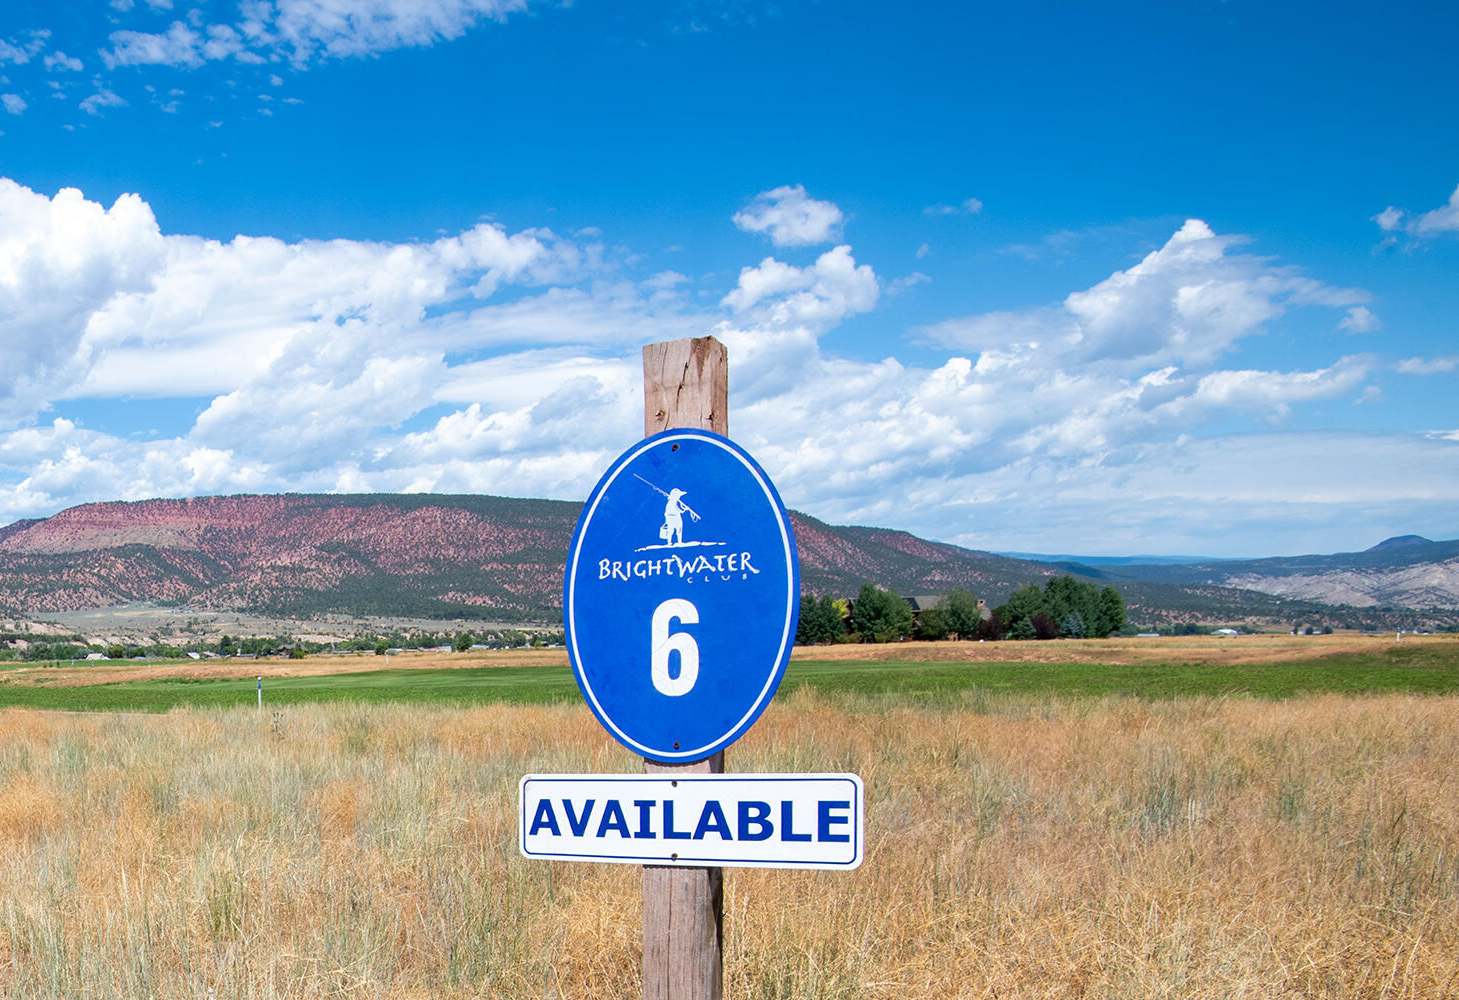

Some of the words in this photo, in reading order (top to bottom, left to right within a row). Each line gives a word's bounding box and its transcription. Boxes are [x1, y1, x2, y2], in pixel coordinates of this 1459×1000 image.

[598, 551, 760, 582] BRIGHTWATER
[687, 572, 748, 584] CLUB
[651, 598, 700, 697] 6
[528, 798, 851, 843] AVAILABLE
